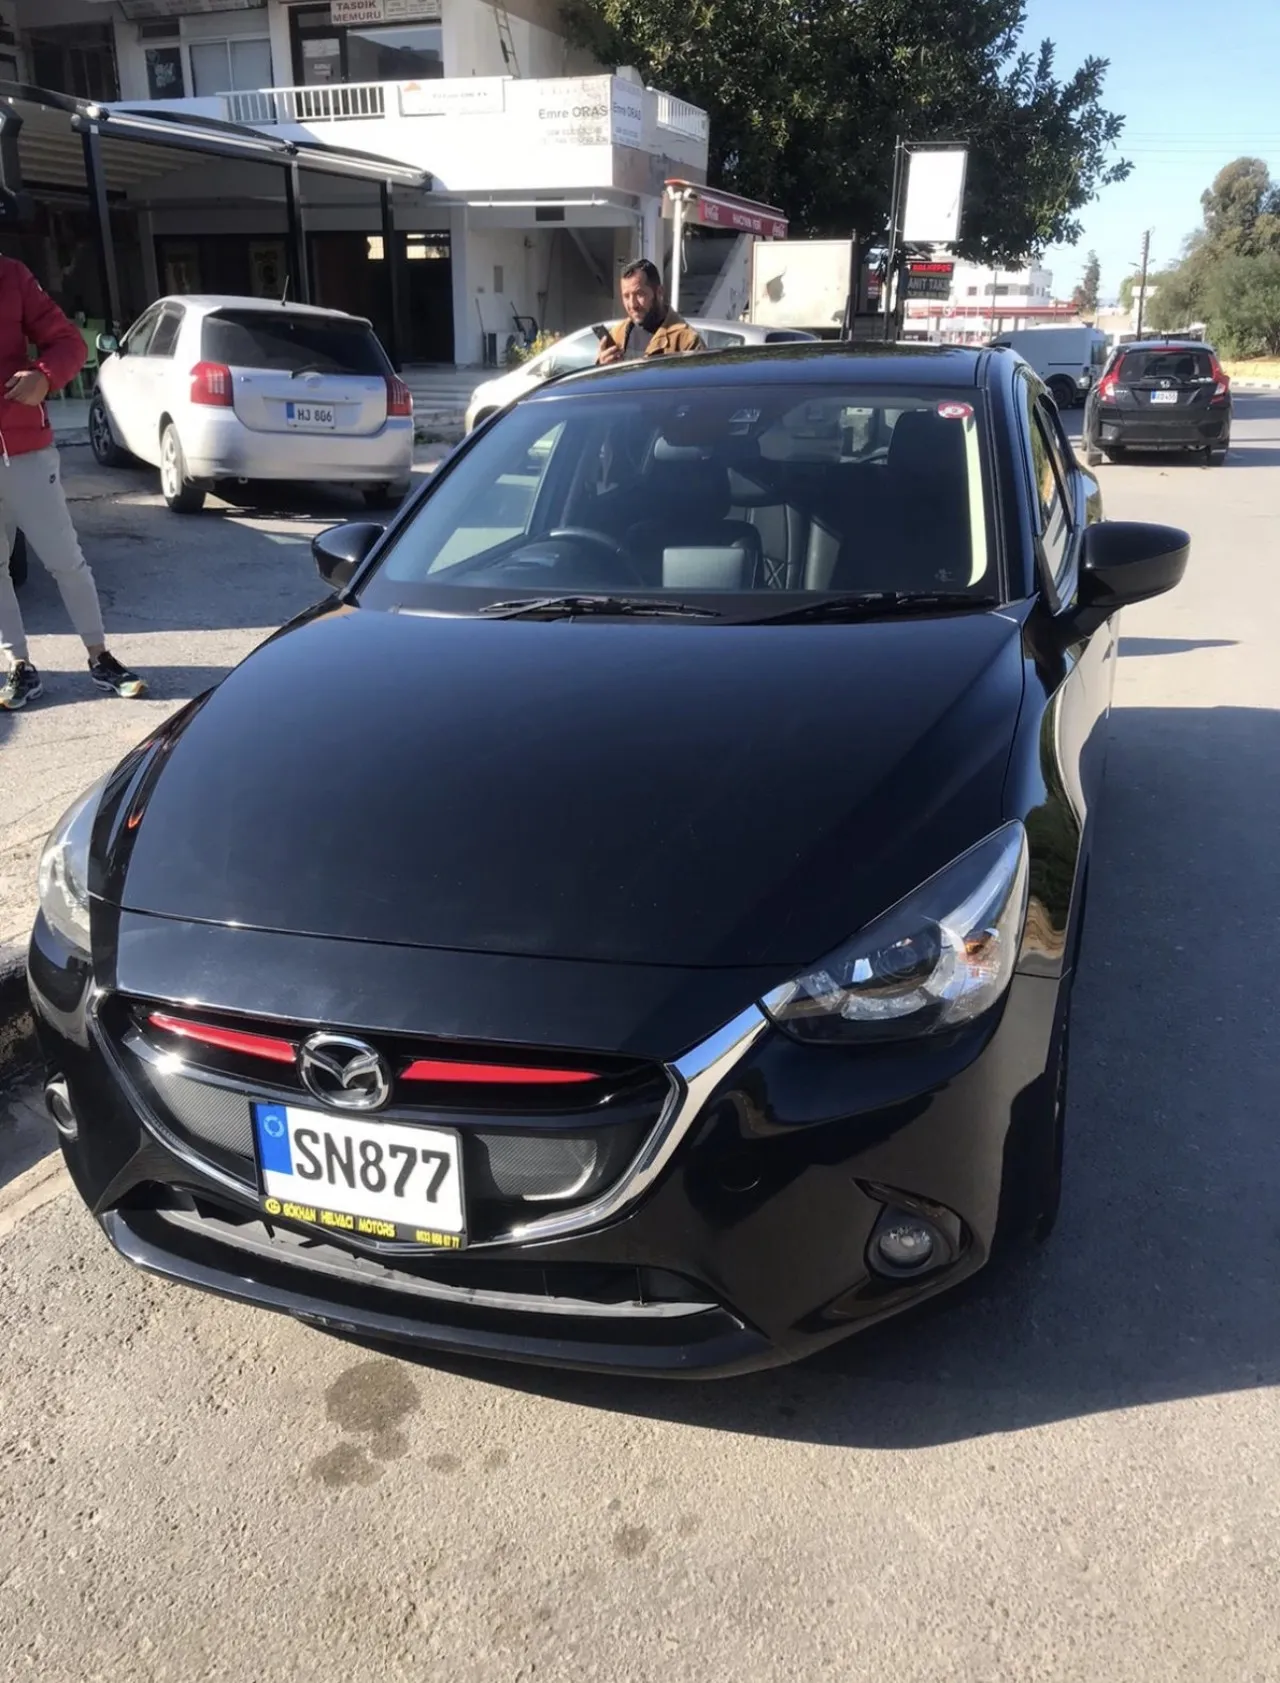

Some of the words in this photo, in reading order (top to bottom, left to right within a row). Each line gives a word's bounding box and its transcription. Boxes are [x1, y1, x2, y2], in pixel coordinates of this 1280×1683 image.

[333, 10, 381, 22] MEMURU
[538, 108, 569, 119] Emre
[572, 105, 608, 117] ORAS
[297, 408, 311, 421] HJ
[293, 1128, 451, 1203] SN877
[359, 1217, 396, 1238] MOTORS
